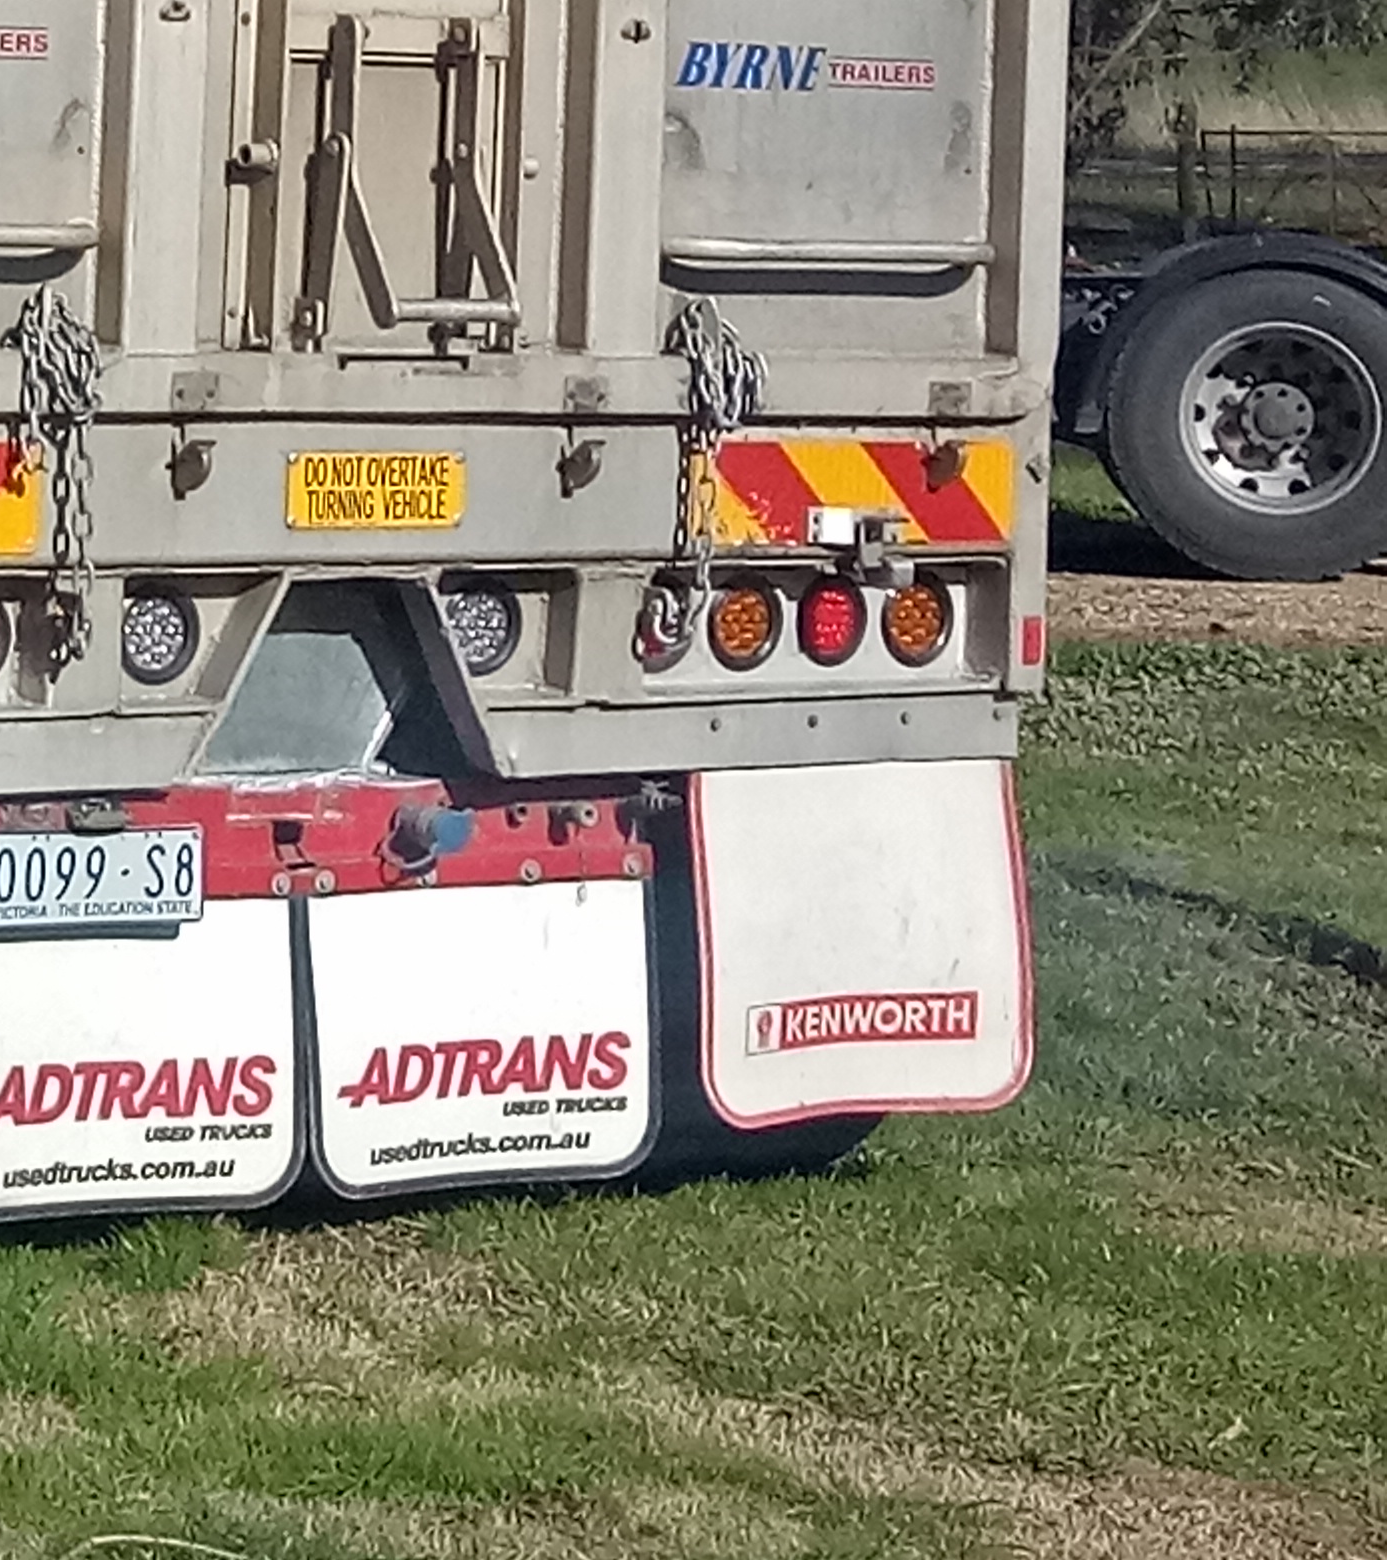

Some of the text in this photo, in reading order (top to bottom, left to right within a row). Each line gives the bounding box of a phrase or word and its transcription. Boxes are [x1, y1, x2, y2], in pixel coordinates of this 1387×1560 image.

[675, 42, 935, 91] BYRNE TRAILERS
[305, 456, 449, 487] DO NOT OVERTAKE
[307, 490, 446, 520] TURNING VEHICLE
[59, 903, 80, 917] THE
[84, 901, 153, 917] EDUCATION
[157, 900, 192, 915] STATE
[786, 998, 970, 1042] KENWORTH
[337, 1031, 631, 1108] ADTRANS
[503, 1096, 628, 1116] USED TRUCKS
[145, 1124, 273, 1142] USED TRUCKS
[370, 1132, 591, 1166] usedtrucks.com.au
[3, 1158, 235, 1188] usedtrucks.com.au
